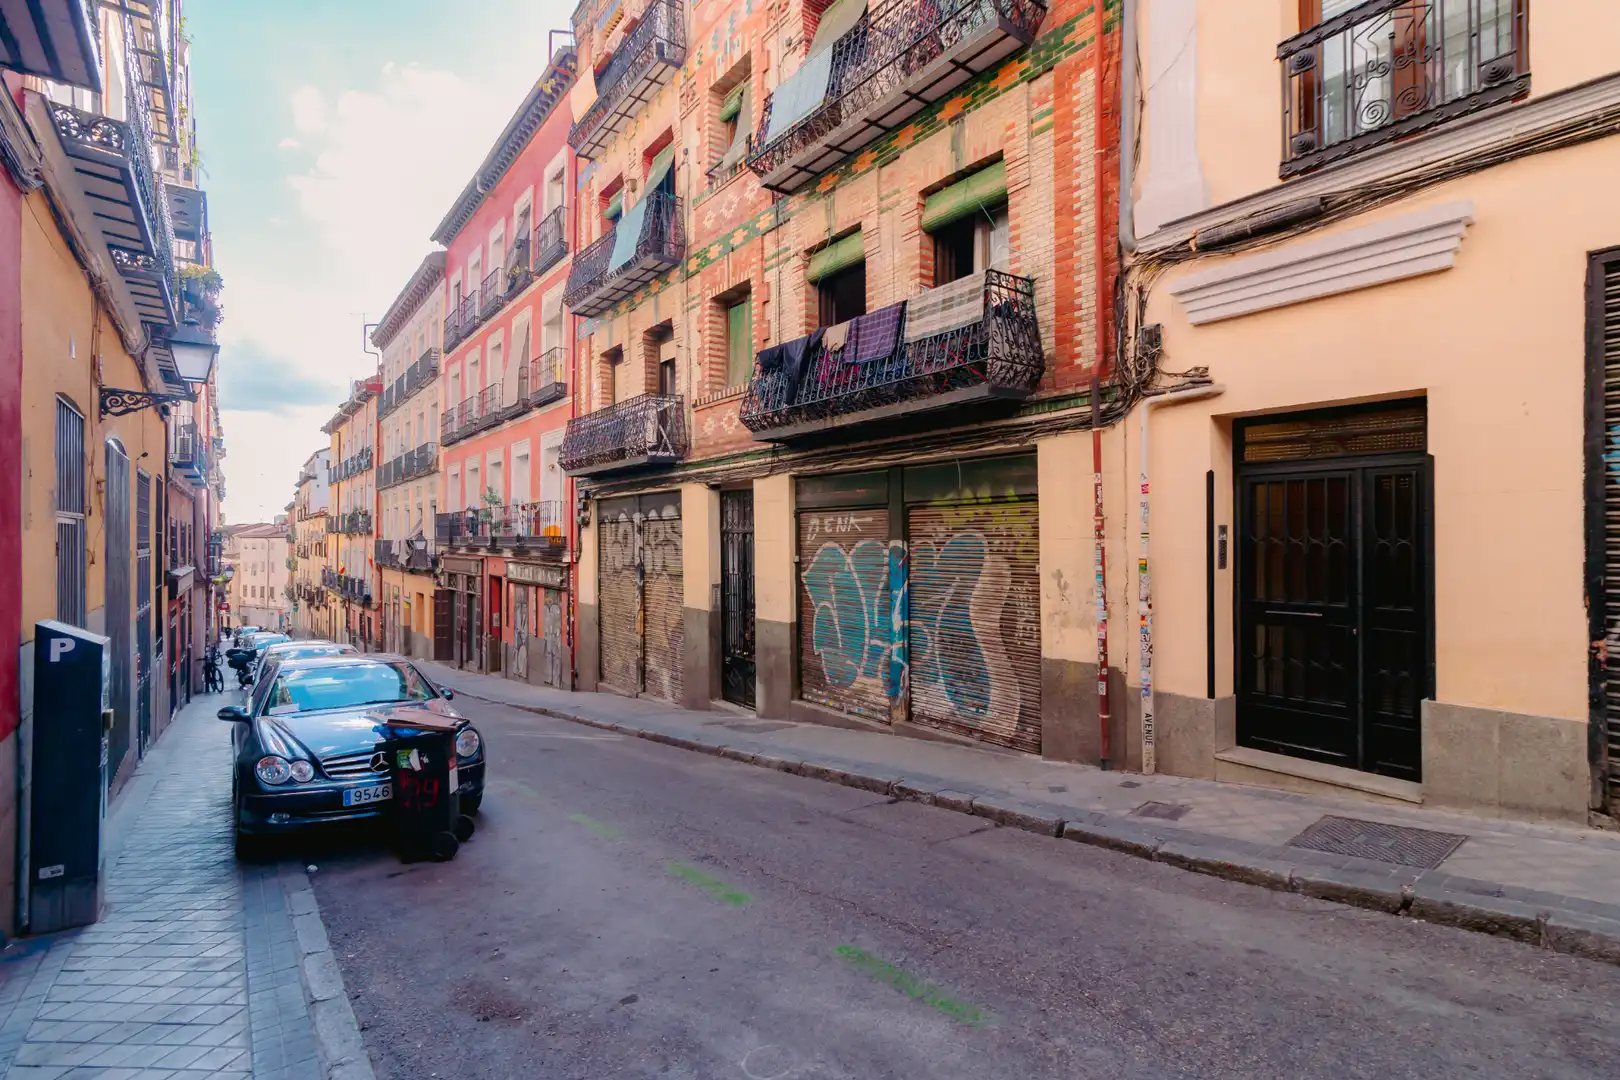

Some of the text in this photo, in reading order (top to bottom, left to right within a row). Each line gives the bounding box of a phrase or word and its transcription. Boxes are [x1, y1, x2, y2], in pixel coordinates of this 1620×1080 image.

[50, 637, 76, 663] P
[1144, 712, 1153, 746] AVENUE
[354, 785, 390, 802] 9546
